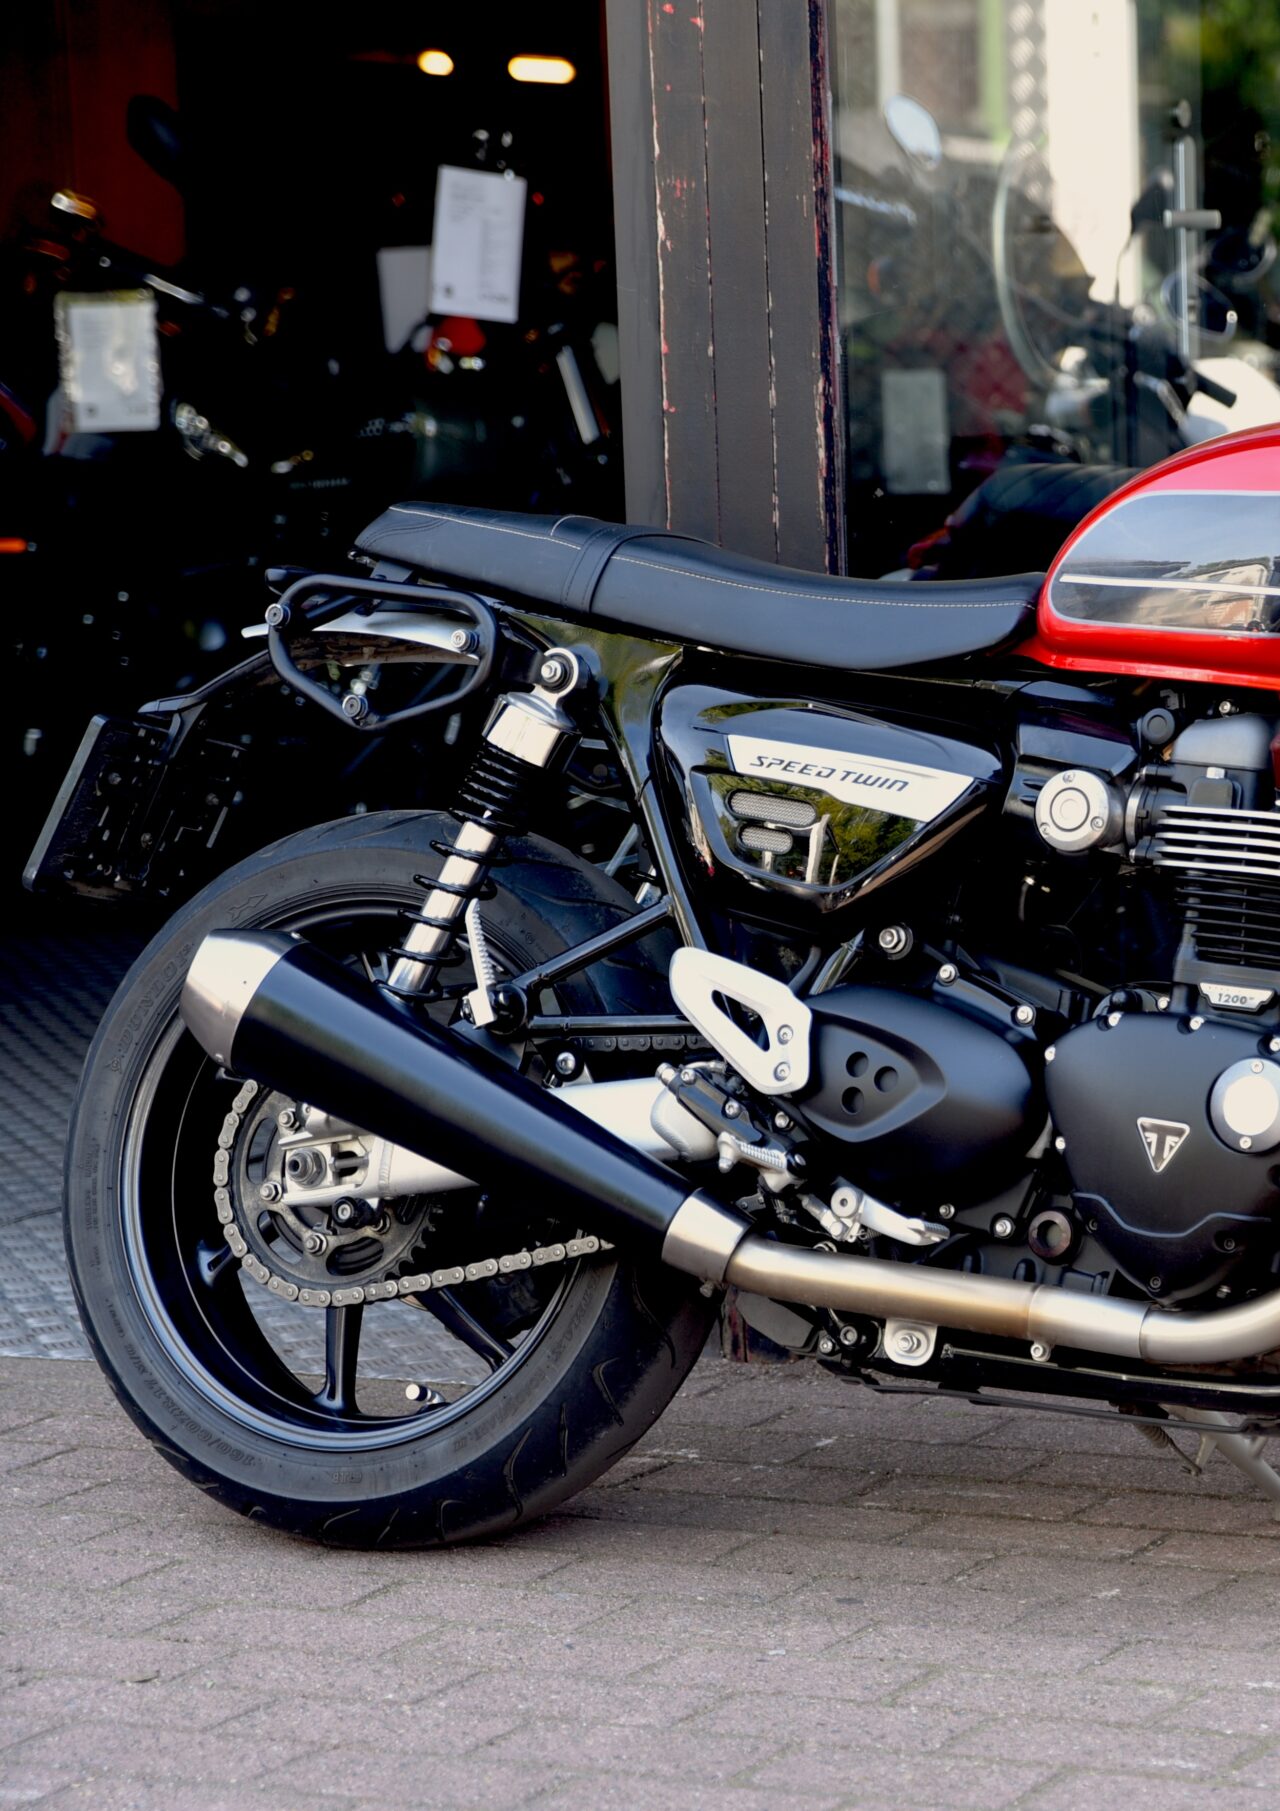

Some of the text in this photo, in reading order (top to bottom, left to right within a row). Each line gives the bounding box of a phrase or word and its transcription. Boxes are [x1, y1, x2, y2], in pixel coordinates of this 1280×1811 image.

[750, 755, 909, 792] SPEED TWIN
[1218, 993, 1247, 1004] 1200
